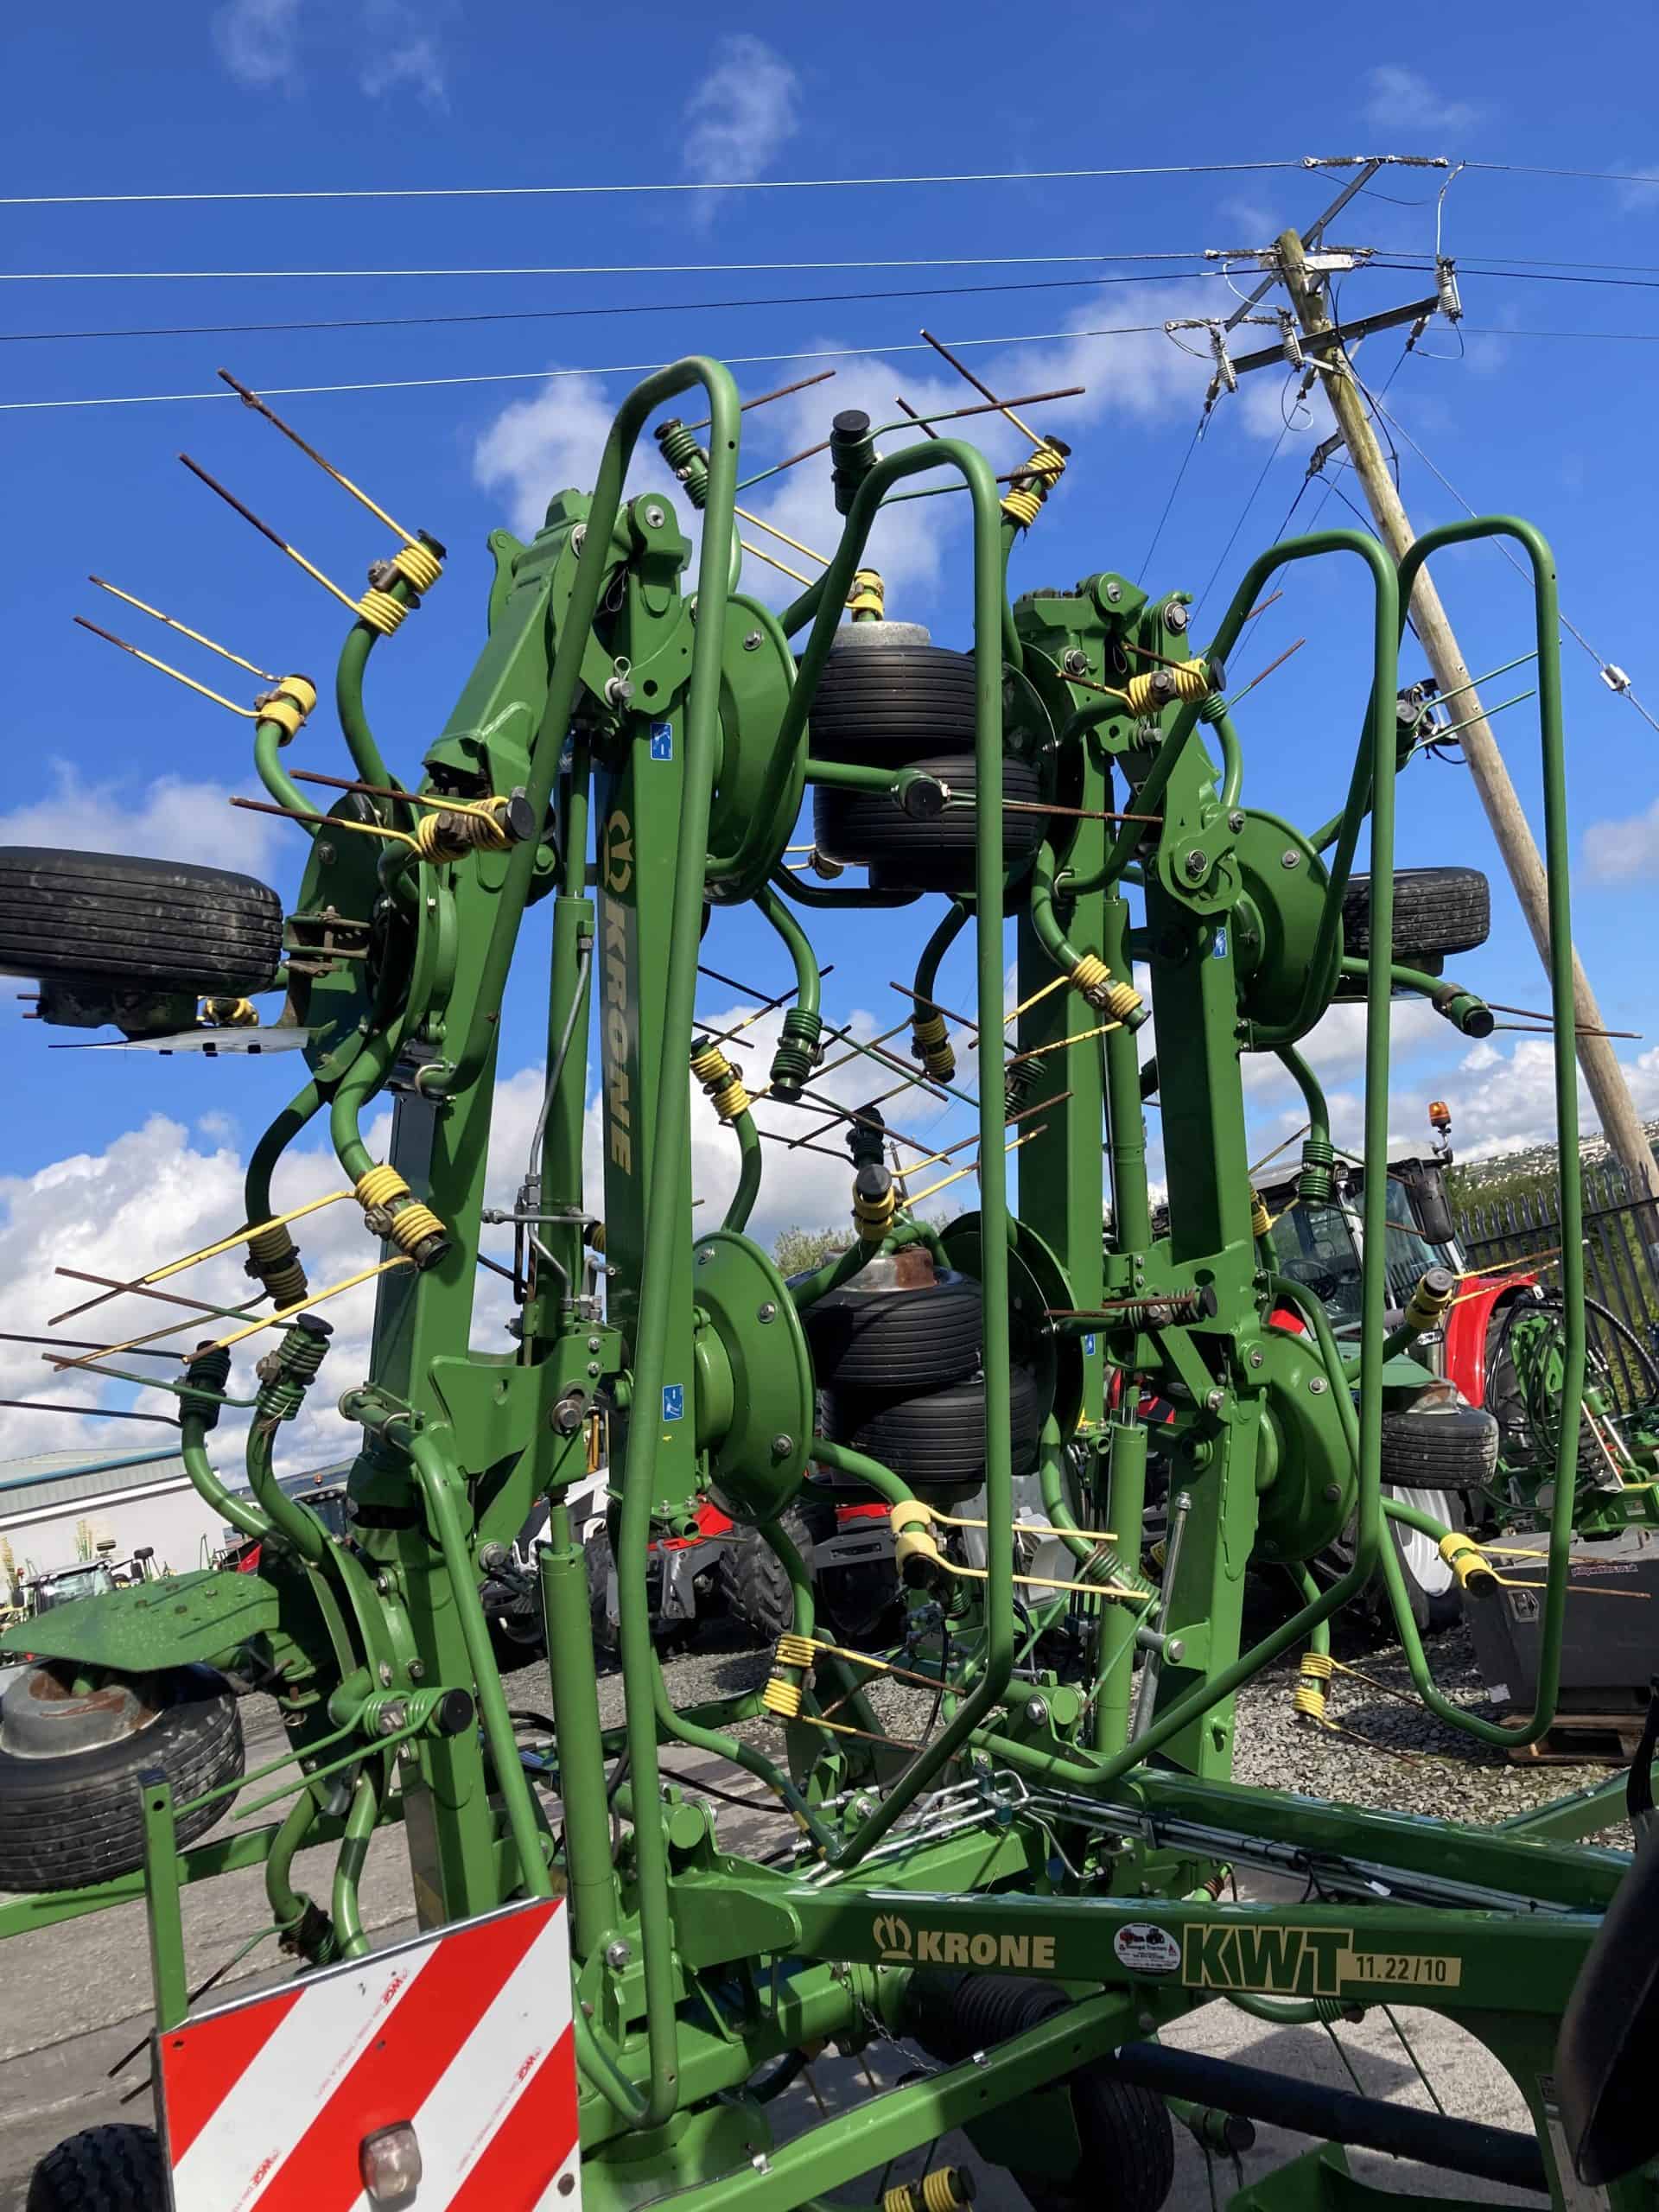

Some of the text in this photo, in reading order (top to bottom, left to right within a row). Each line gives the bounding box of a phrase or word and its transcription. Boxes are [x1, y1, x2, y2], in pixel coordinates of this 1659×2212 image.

[605, 898, 632, 1176] KRONE
[916, 1931, 1056, 1969] KRONE
[1181, 1922, 1447, 1997] KWT 11.22/10
